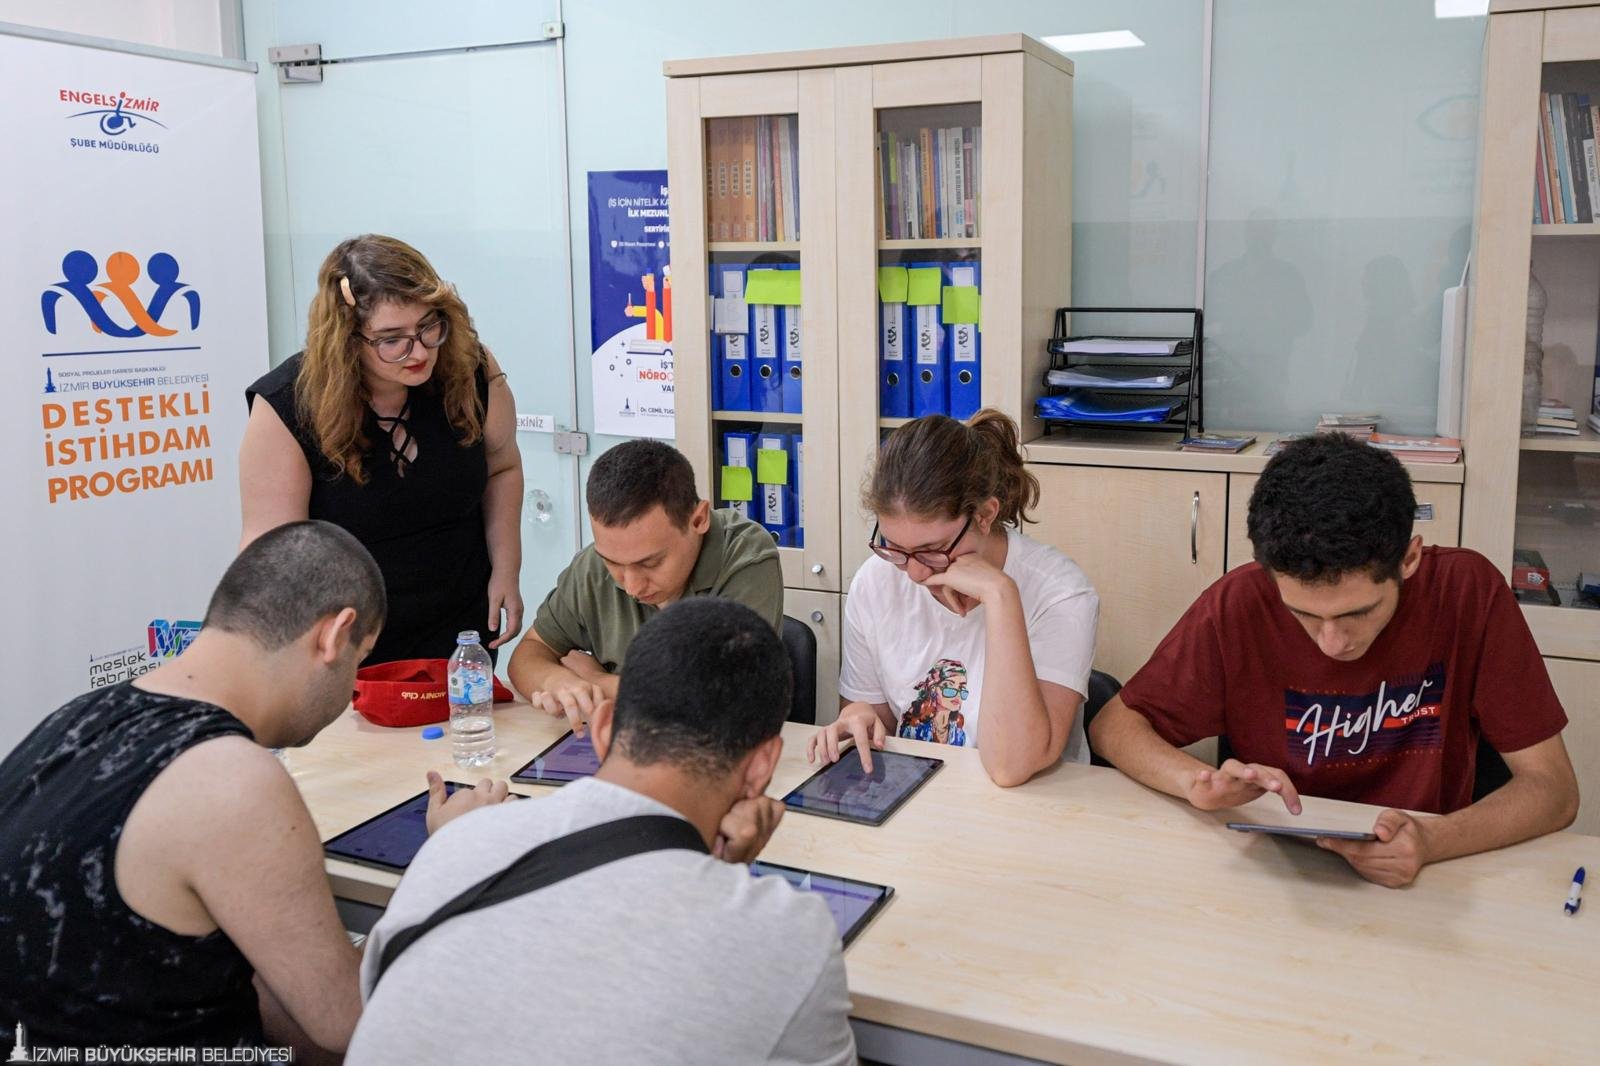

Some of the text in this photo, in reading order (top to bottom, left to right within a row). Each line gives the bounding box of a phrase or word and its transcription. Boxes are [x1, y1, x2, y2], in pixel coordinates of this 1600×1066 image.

[70, 137, 159, 154] ŞUBE MÜDÜRLÜĞÜ
[627, 207, 639, 218] İLK
[59, 373, 209, 393] İZMİR BÜYÜKŞEHİR BELEDİYESİ
[42, 384, 210, 429] DESTEKLİ
[44, 424, 211, 467] İSTİHDAM
[48, 458, 213, 504] PROGRAMI
[90, 651, 146, 676] meslek
[1296, 680, 1433, 765] Higher
[1400, 706, 1437, 725] TRUST
